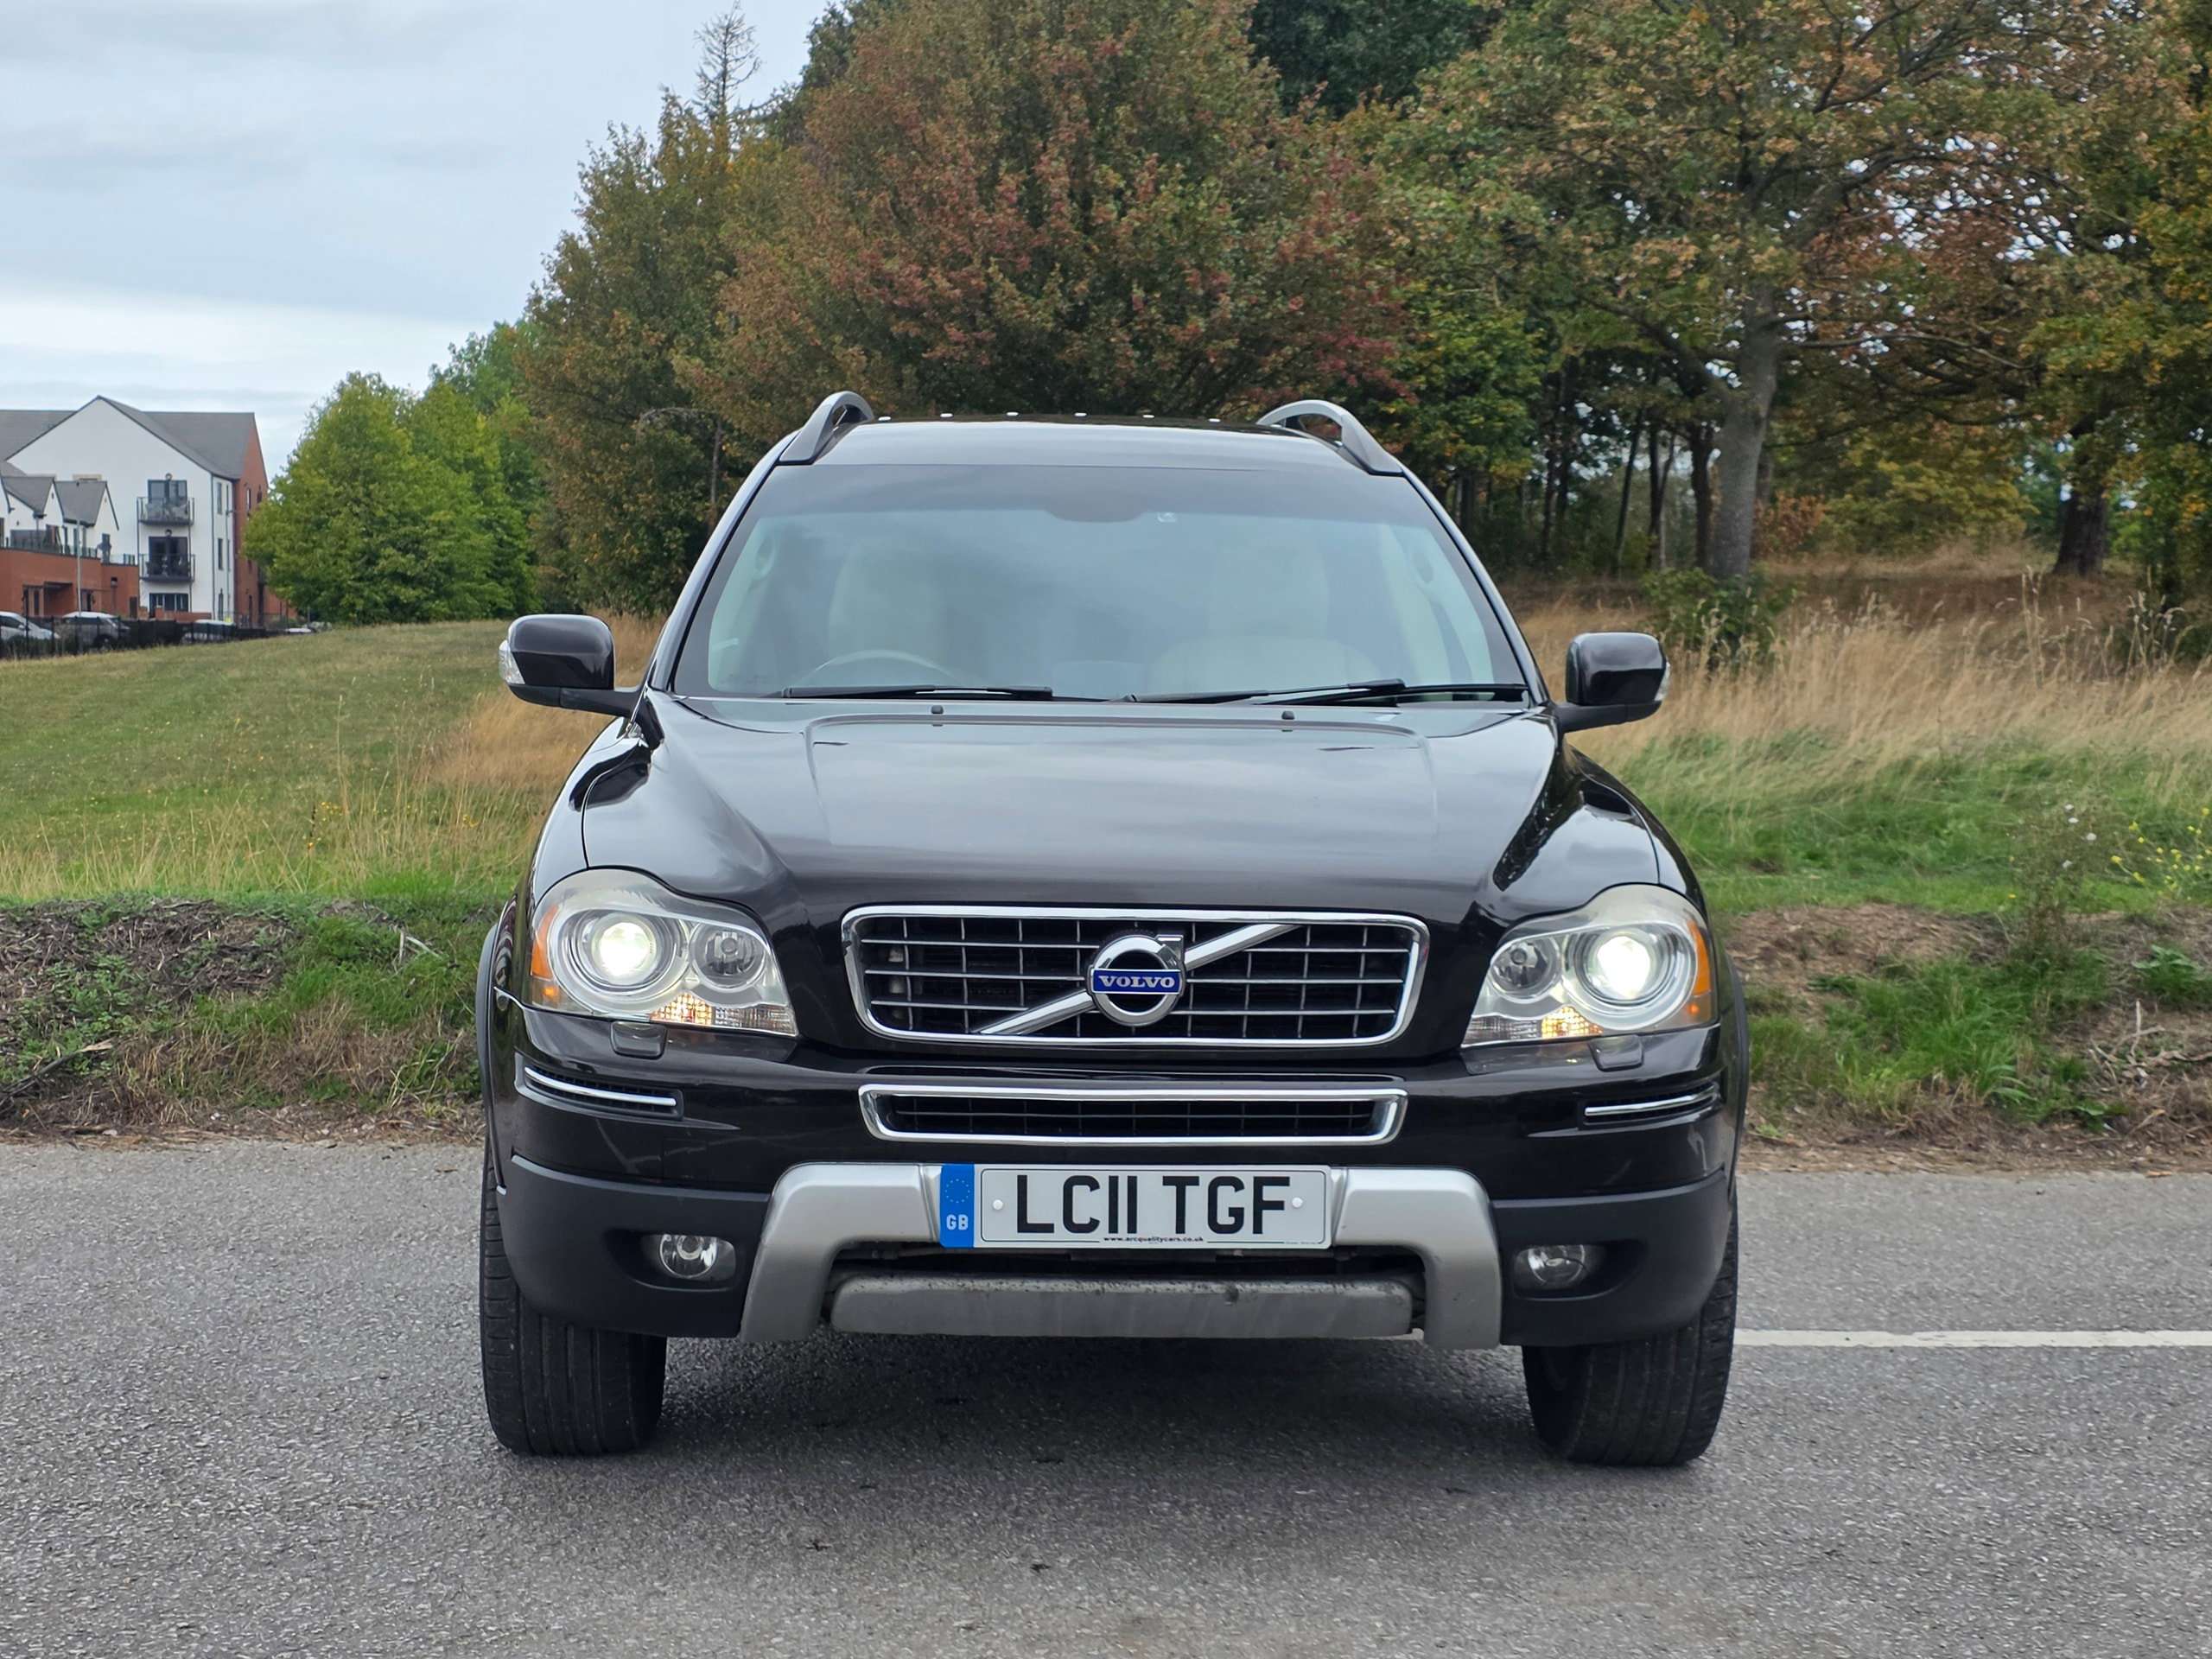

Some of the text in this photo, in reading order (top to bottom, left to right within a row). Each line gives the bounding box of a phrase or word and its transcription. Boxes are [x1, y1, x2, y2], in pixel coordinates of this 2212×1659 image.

[1098, 976, 1175, 988] VOLVO
[1017, 1175, 1291, 1235] LC11 TGF
[946, 1214, 969, 1230] GB
